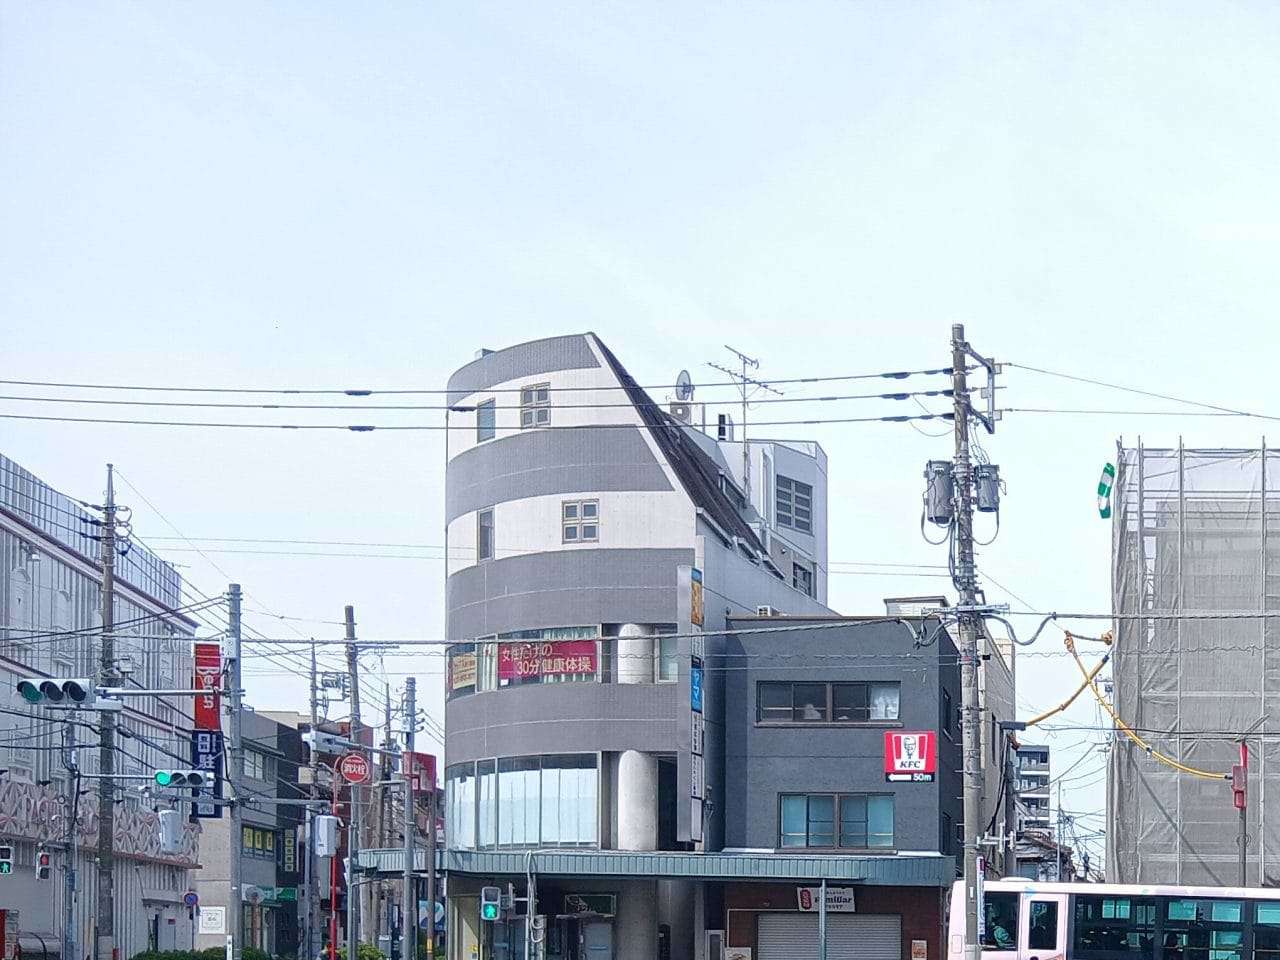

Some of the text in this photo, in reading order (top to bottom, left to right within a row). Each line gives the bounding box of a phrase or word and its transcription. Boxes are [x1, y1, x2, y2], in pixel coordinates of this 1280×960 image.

[503, 644, 553, 662] 女性だけの
[517, 656, 592, 675] 30分健康体操
[344, 763, 366, 775] 消火栓
[900, 760, 921, 769] KFC
[912, 773, 932, 782] 50m
